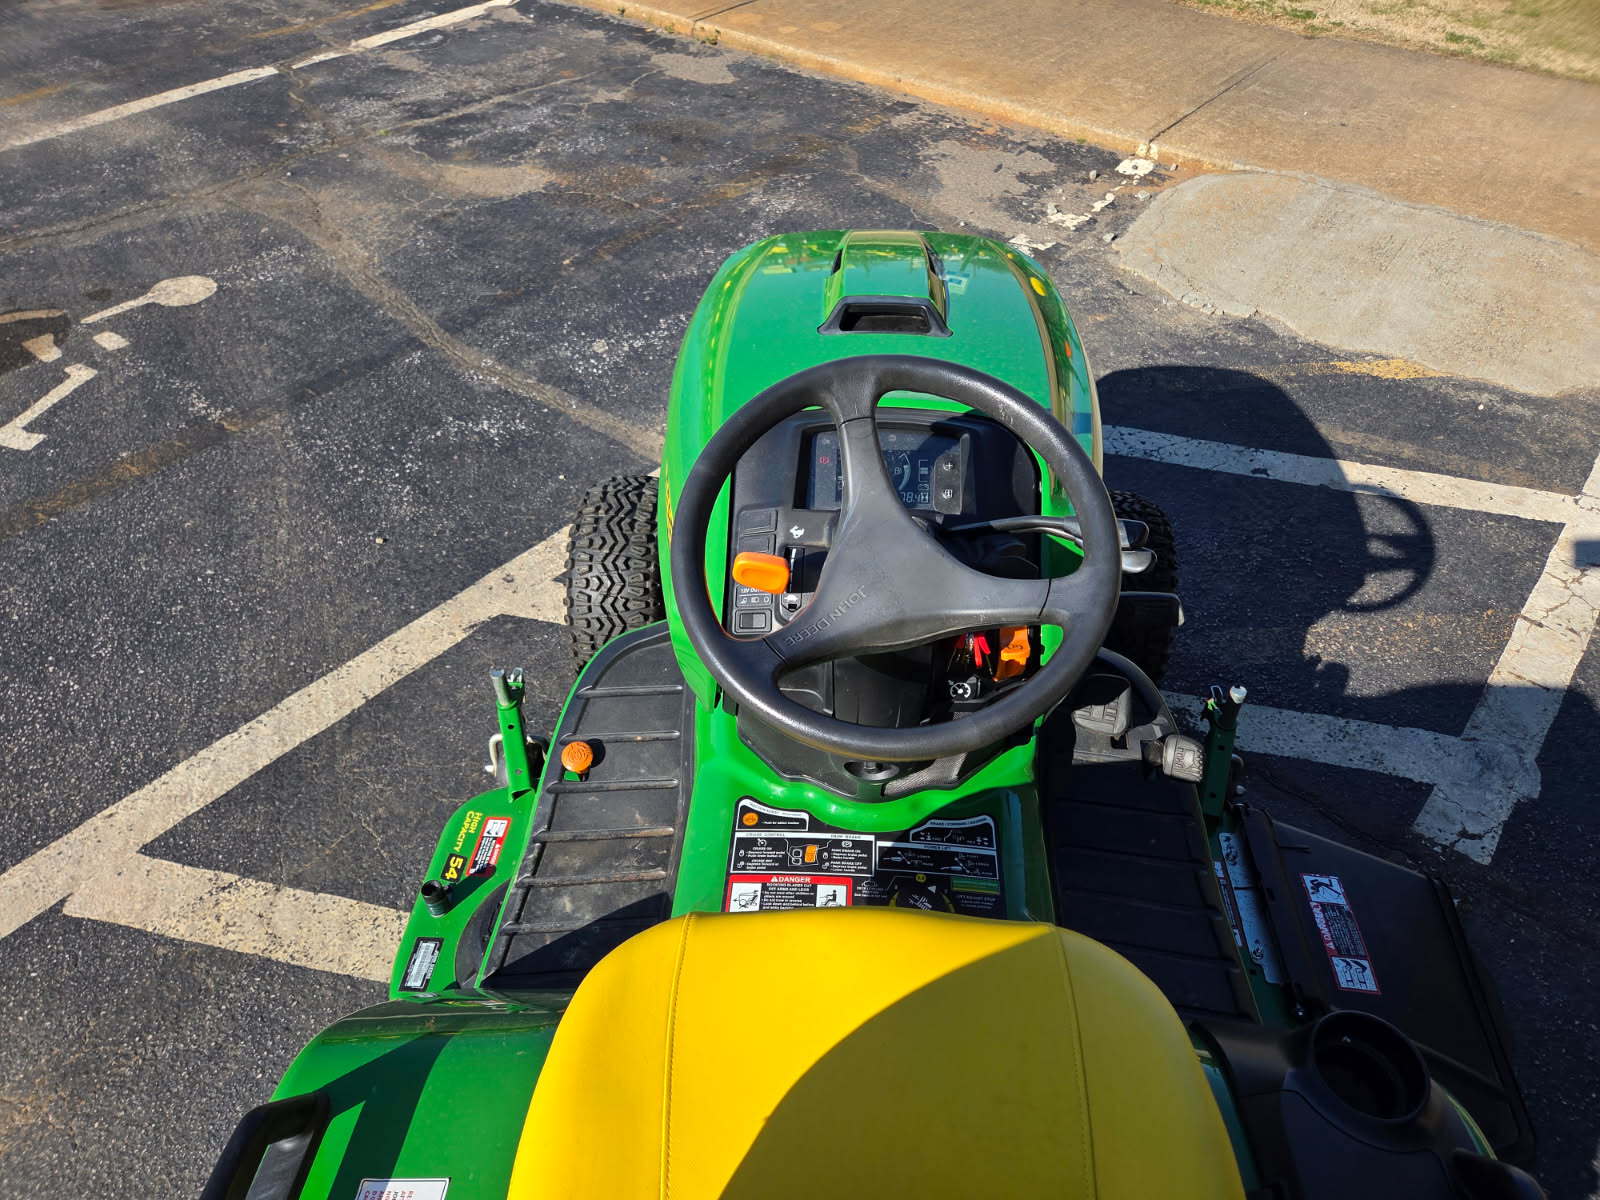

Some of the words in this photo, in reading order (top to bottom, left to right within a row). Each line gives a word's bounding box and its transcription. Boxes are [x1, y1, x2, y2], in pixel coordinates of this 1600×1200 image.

[829, 584, 867, 620] JOHN
[784, 616, 831, 647] DEERE
[453, 810, 474, 852] CAPACITY
[469, 812, 482, 833] HIGH
[444, 856, 464, 880] 54
